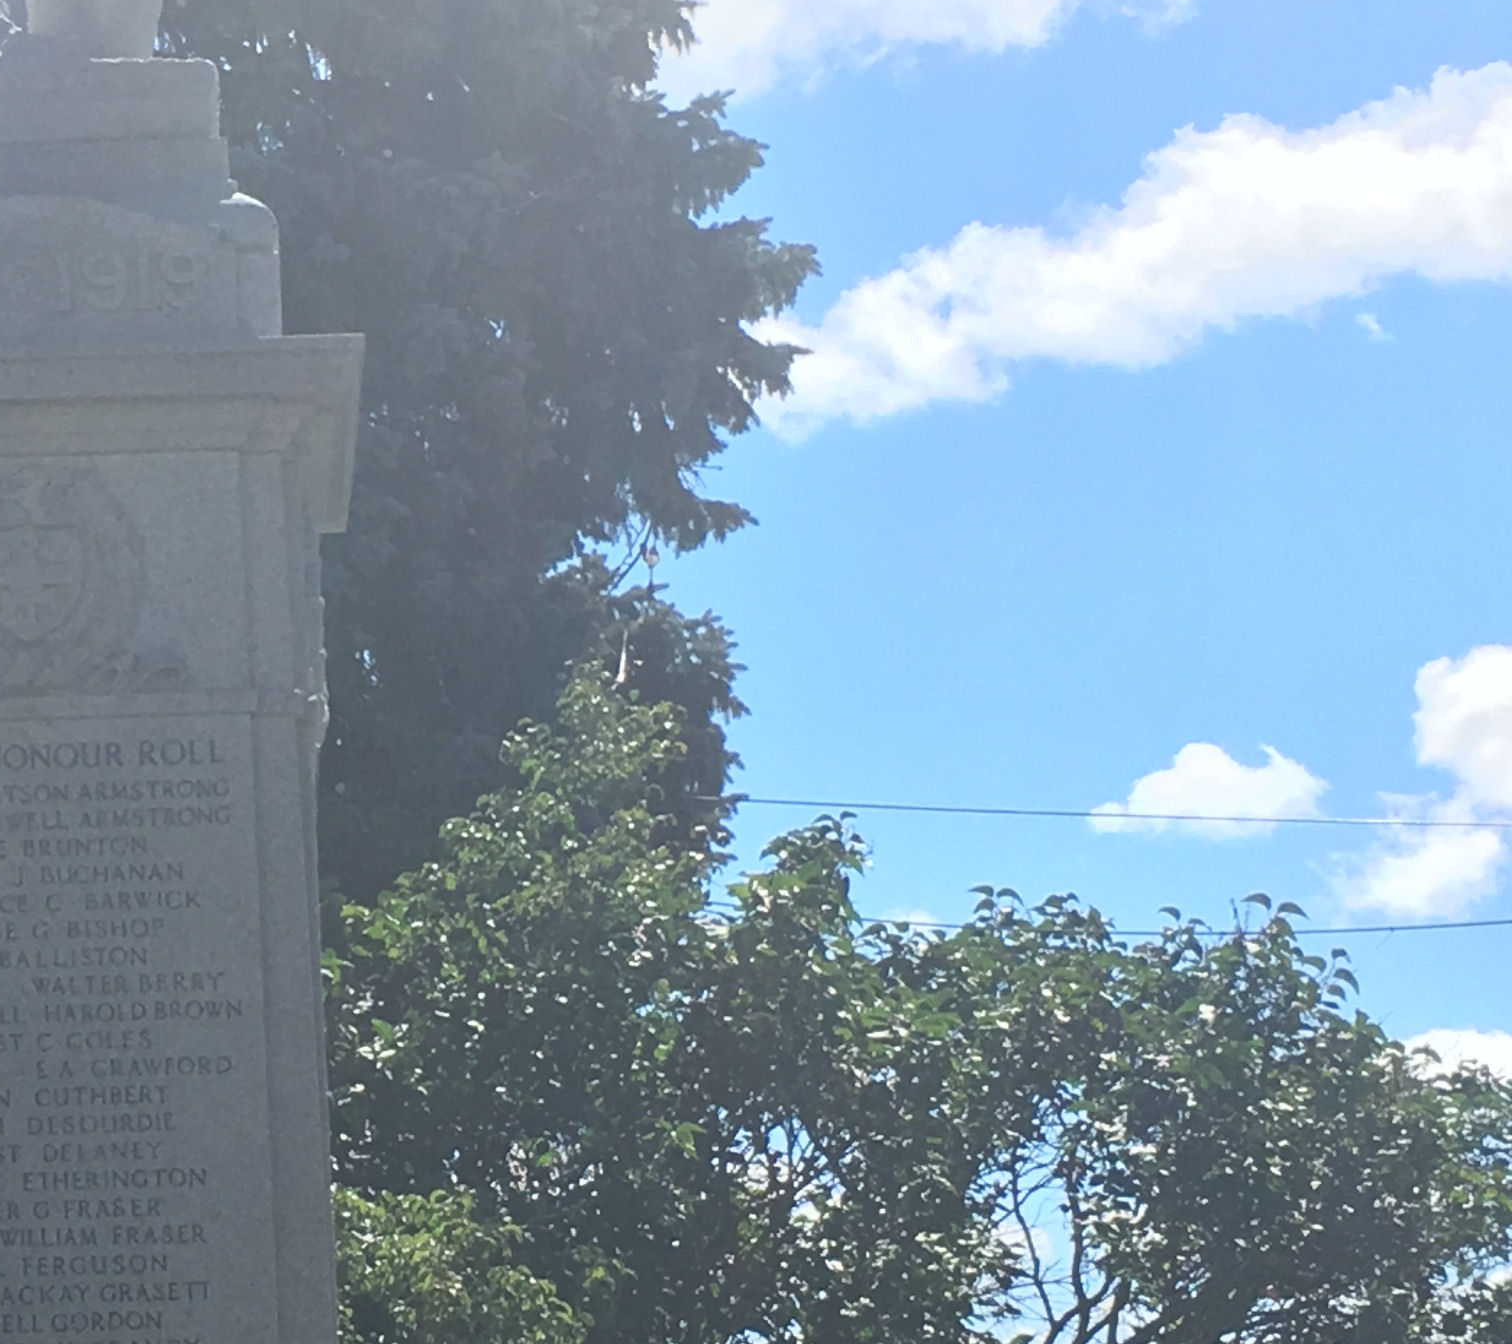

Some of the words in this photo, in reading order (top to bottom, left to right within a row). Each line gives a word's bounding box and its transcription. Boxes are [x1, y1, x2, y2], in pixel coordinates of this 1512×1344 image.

[56, 252, 205, 313] 1919
[138, 738, 226, 767] ROLL
[76, 777, 229, 802] ARMSTRONG
[78, 805, 231, 830] ARMSTRONG
[23, 837, 148, 858] BRUNTON
[40, 862, 184, 884] BUCHANAN
[85, 891, 201, 912] BARWICK
[67, 917, 165, 940] BISHOP
[31, 974, 129, 995] WALTER
[139, 971, 225, 993] BERRY
[44, 1002, 147, 1023] HAROLD
[154, 999, 243, 1021] BROWN
[91, 1055, 233, 1078] CRAWFORD
[34, 1085, 170, 1107] CUTHBERT
[42, 1142, 162, 1164] DELANEY
[22, 1167, 208, 1192] ETHERINGTON
[63, 1198, 162, 1219] FRASER
[0, 1228, 98, 1249] WILLIAM
[112, 1224, 208, 1246] FRASER
[23, 1254, 169, 1276] FERGUSON
[99, 1281, 210, 1302] GRASETT
[51, 1311, 163, 1333] GORDON
